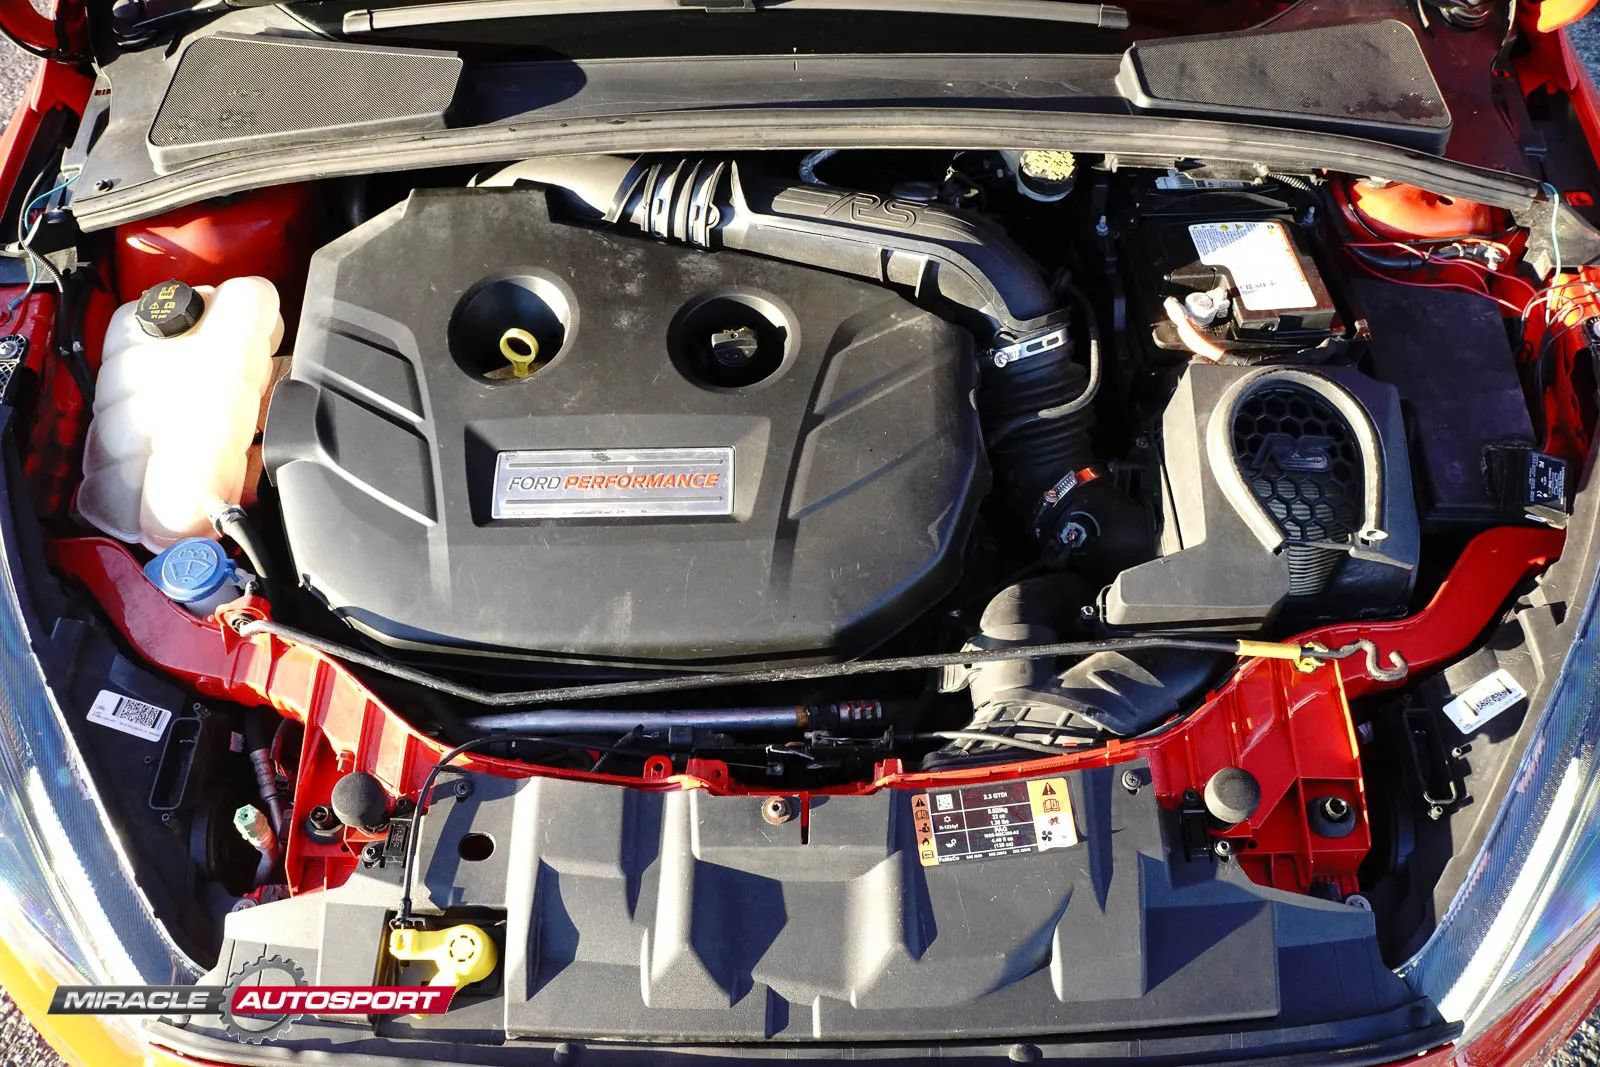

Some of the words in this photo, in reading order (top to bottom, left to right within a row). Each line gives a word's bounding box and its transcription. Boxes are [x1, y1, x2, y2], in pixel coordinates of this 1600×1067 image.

[824, 191, 917, 228] RS
[508, 476, 562, 491] FORD
[563, 472, 720, 490] PERFORMANCE
